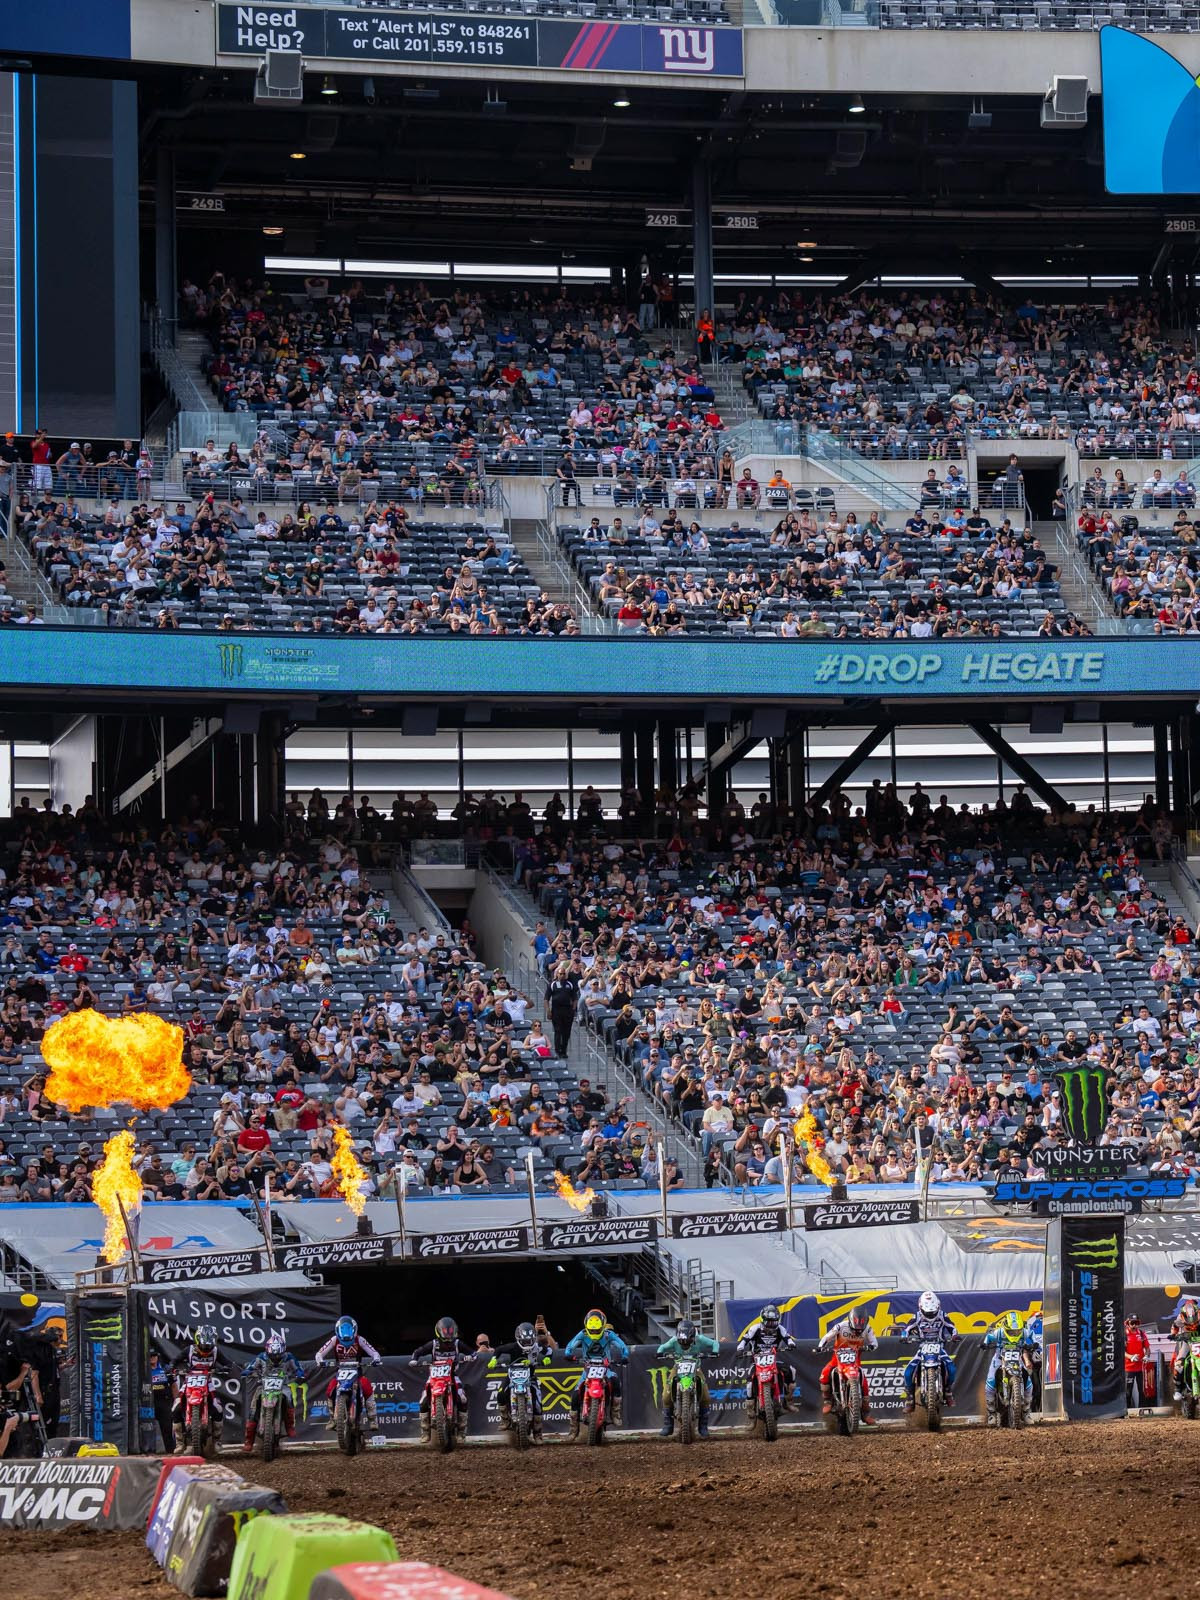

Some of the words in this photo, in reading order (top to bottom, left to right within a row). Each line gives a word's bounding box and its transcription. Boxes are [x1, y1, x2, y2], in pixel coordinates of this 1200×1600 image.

[237, 7, 297, 28] Need
[338, 18, 368, 32] Text
[460, 25, 474, 36] to
[478, 25, 530, 39] 848261
[237, 28, 305, 51] Help?
[353, 38, 368, 49] or
[372, 37, 399, 50] Call
[404, 39, 504, 55] 201.559.1515
[192, 198, 224, 210] 249B
[647, 214, 678, 226] 249B
[727, 216, 758, 228] 250B
[1166, 220, 1197, 230] 250B
[236, 480, 251, 488] 248
[767, 489, 787, 497] 249A
[814, 652, 942, 682] #DROP
[961, 651, 1104, 681] HEGATE
[1036, 1147, 1138, 1166] MONSTER
[1000, 1173, 1021, 1184] AMA
[1051, 1167, 1123, 1176] ENERGY
[994, 1179, 1186, 1201] SUPERCROSS
[829, 1204, 860, 1214] ROCKY
[860, 1202, 911, 1212] MOUNTAIN
[1048, 1200, 1133, 1214] Championship
[695, 1214, 726, 1224] ROCKY
[727, 1211, 778, 1222] MOUNTAIN
[566, 1223, 597, 1234] ROCKY
[598, 1219, 650, 1231] MOUNTAIN
[435, 1233, 466, 1245] ROCKY
[467, 1229, 519, 1241] MOUNTAIN
[299, 1245, 331, 1256] ROCKY
[331, 1239, 384, 1251] MOUNTAIN
[167, 1258, 199, 1269] ROCKY
[200, 1253, 252, 1265] MOUNTAIN
[1091, 1274, 1099, 1291] AMA
[148, 1297, 177, 1316] AH
[190, 1301, 287, 1320] SPORTS
[1067, 1298, 1077, 1376] CHAMPIONSHIP
[1080, 1270, 1093, 1405] SUPERCROSS
[1103, 1300, 1117, 1373] MONSTER
[921, 1343, 941, 1354] 468
[755, 1354, 775, 1366] 148
[839, 1352, 856, 1363] 125
[1004, 1351, 1020, 1361] 83
[337, 1369, 357, 1380] 97
[431, 1365, 450, 1377] 682
[511, 1370, 529, 1379] 350
[588, 1367, 607, 1378] 89
[677, 1362, 695, 1374] 351
[187, 1374, 208, 1388] 55
[84, 1362, 92, 1420] CHAMPIONSHIP
[111, 1363, 121, 1417] MONSTER
[865, 1386, 907, 1397] ROSS
[0, 1462, 36, 1485] OCKY
[31, 1460, 115, 1485] MOUNTAIN
